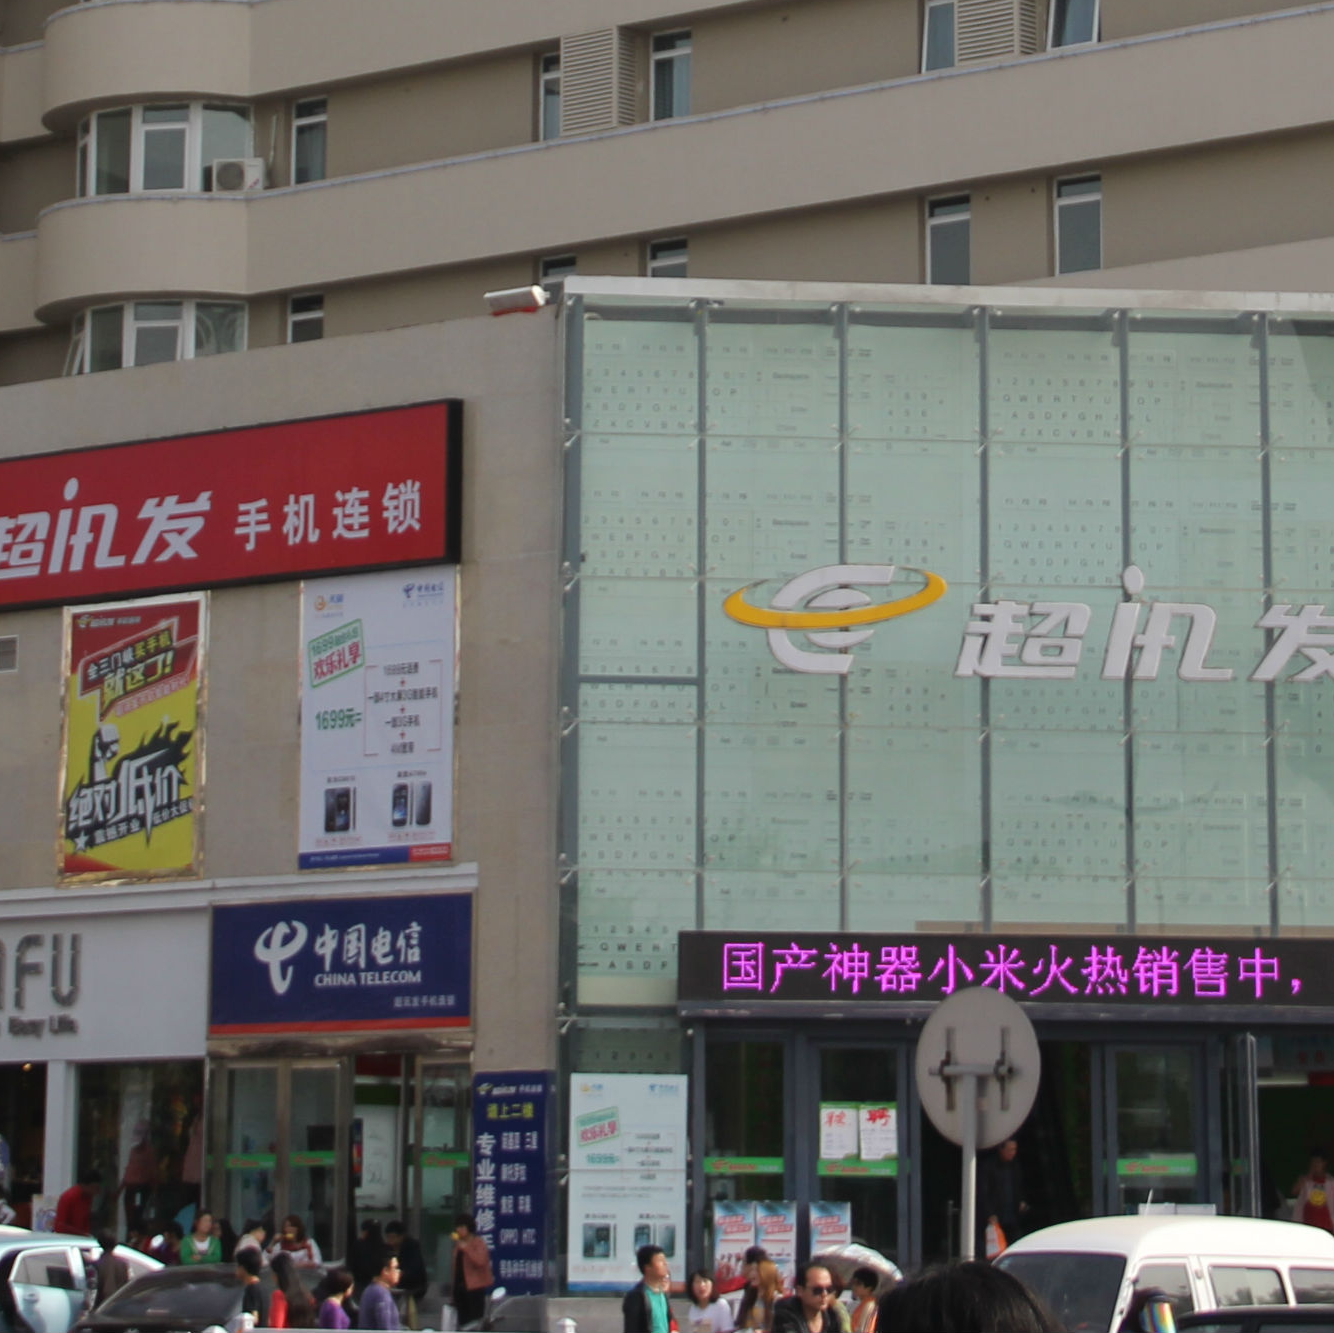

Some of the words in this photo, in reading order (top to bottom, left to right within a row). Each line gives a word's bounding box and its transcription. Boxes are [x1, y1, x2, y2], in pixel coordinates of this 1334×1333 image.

[235, 479, 423, 553] 手机连锁
[68, 748, 183, 832] 绝对低价
[315, 921, 422, 972] 中国电信
[315, 972, 357, 987] CHINA
[359, 969, 422, 985] TELECOM
